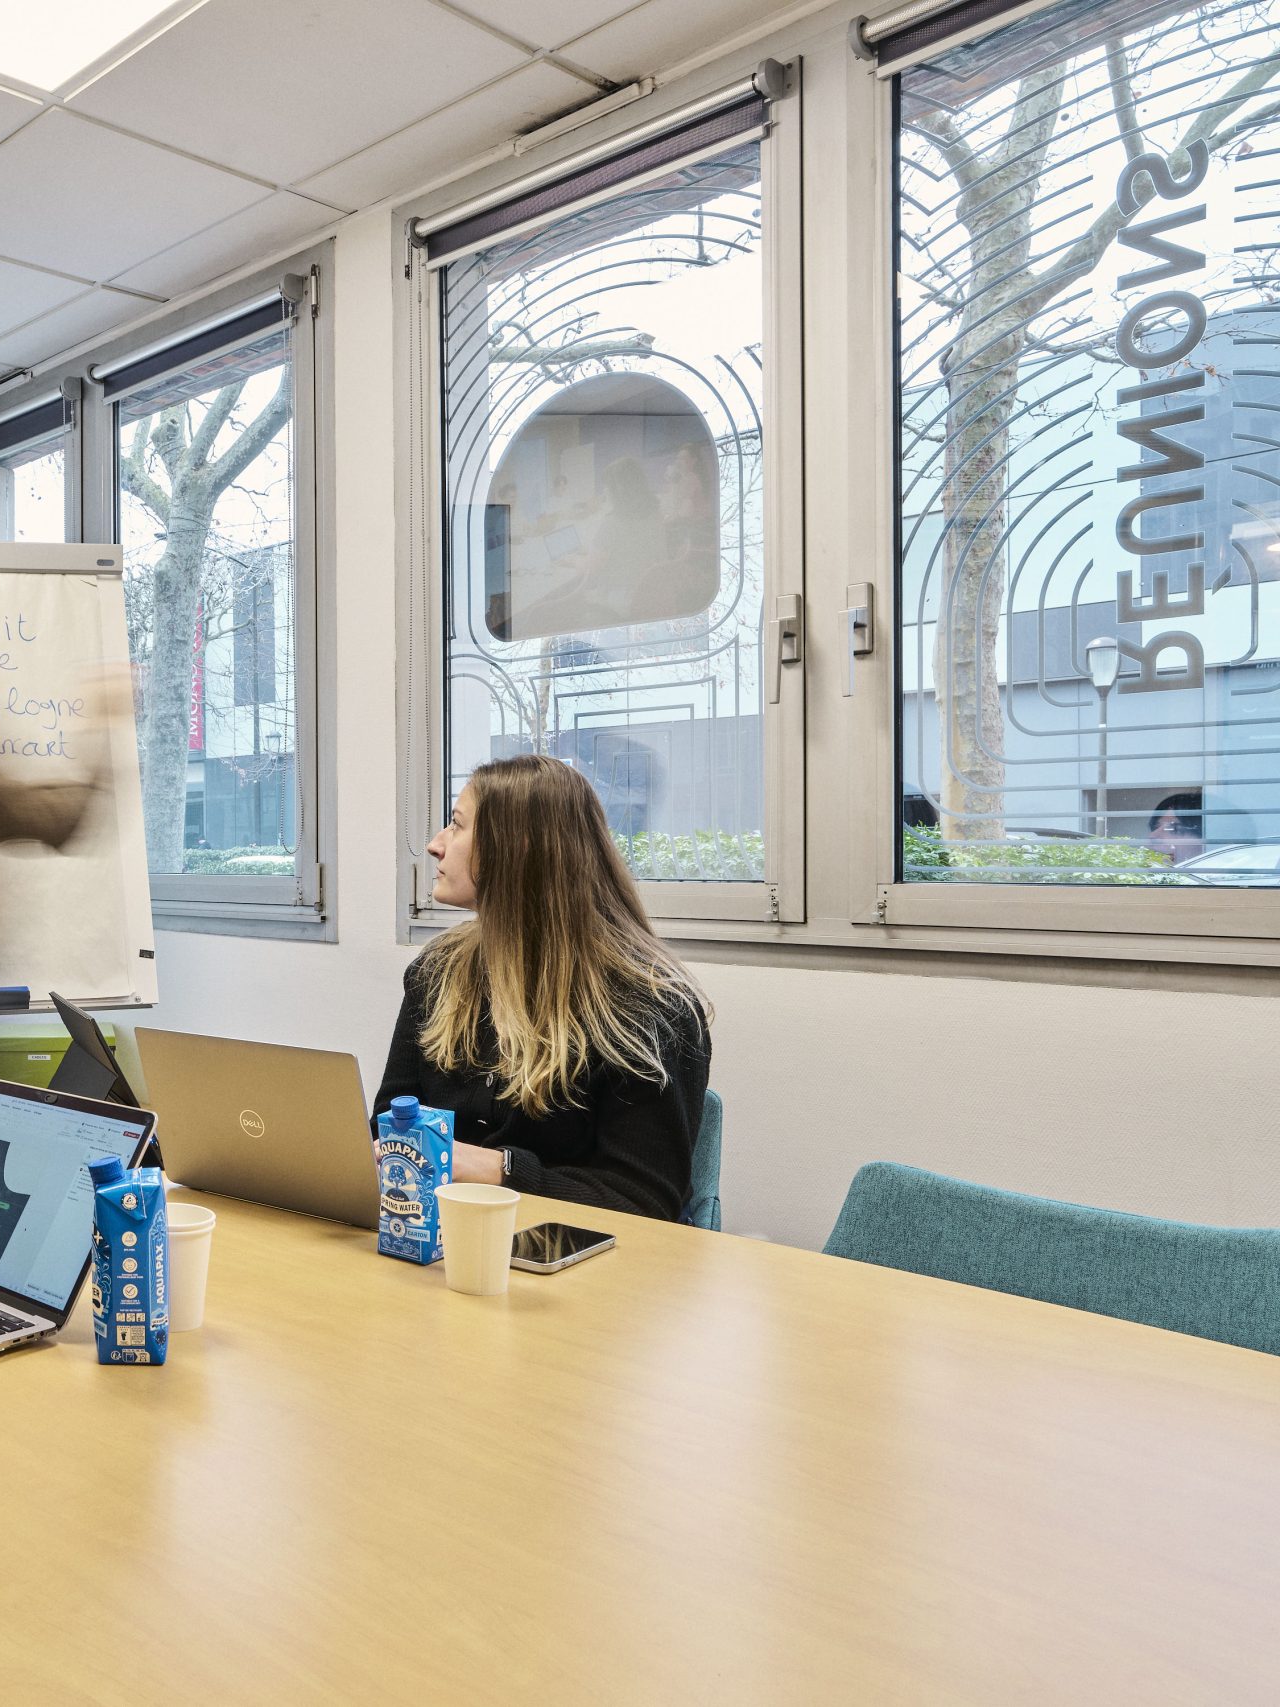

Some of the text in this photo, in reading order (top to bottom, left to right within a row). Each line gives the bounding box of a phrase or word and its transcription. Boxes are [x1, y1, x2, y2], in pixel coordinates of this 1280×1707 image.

[242, 1118, 263, 1129] DELL
[399, 1203, 421, 1212] WATER
[407, 1230, 428, 1239] CARTON
[155, 1243, 165, 1305] AQUAPAX
